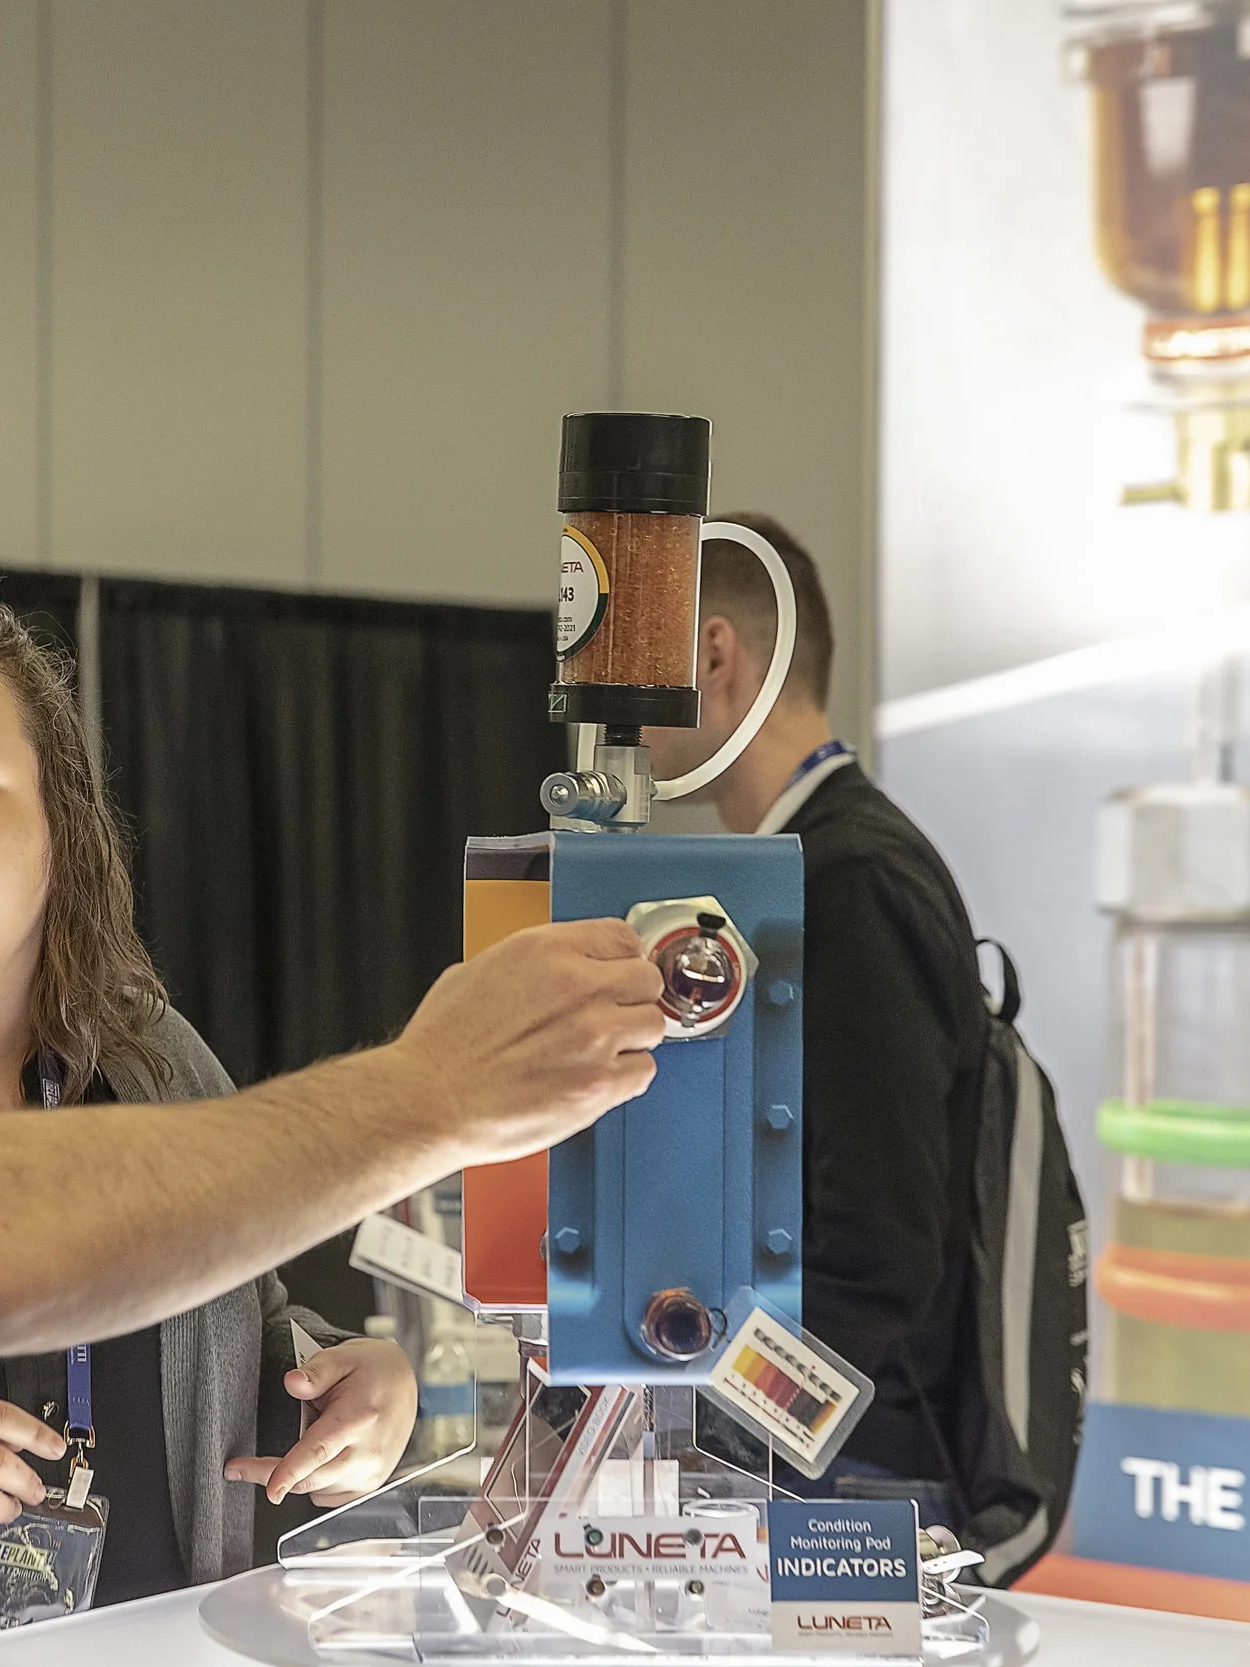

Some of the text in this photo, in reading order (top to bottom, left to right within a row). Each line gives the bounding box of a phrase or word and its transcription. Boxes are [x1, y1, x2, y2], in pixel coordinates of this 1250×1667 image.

[1119, 1456, 1246, 1531] THE
[808, 1518, 872, 1532] Condition
[554, 1532, 747, 1559] LUNETA
[790, 1535, 892, 1553] Monitoring Pod
[554, 1564, 587, 1574] SMART
[590, 1564, 643, 1574] PRODUCTS
[652, 1564, 695, 1574] RELIABLE
[700, 1564, 748, 1574] MACHINES
[777, 1557, 907, 1577] INDICATORS
[797, 1615, 892, 1630] LUNETA
